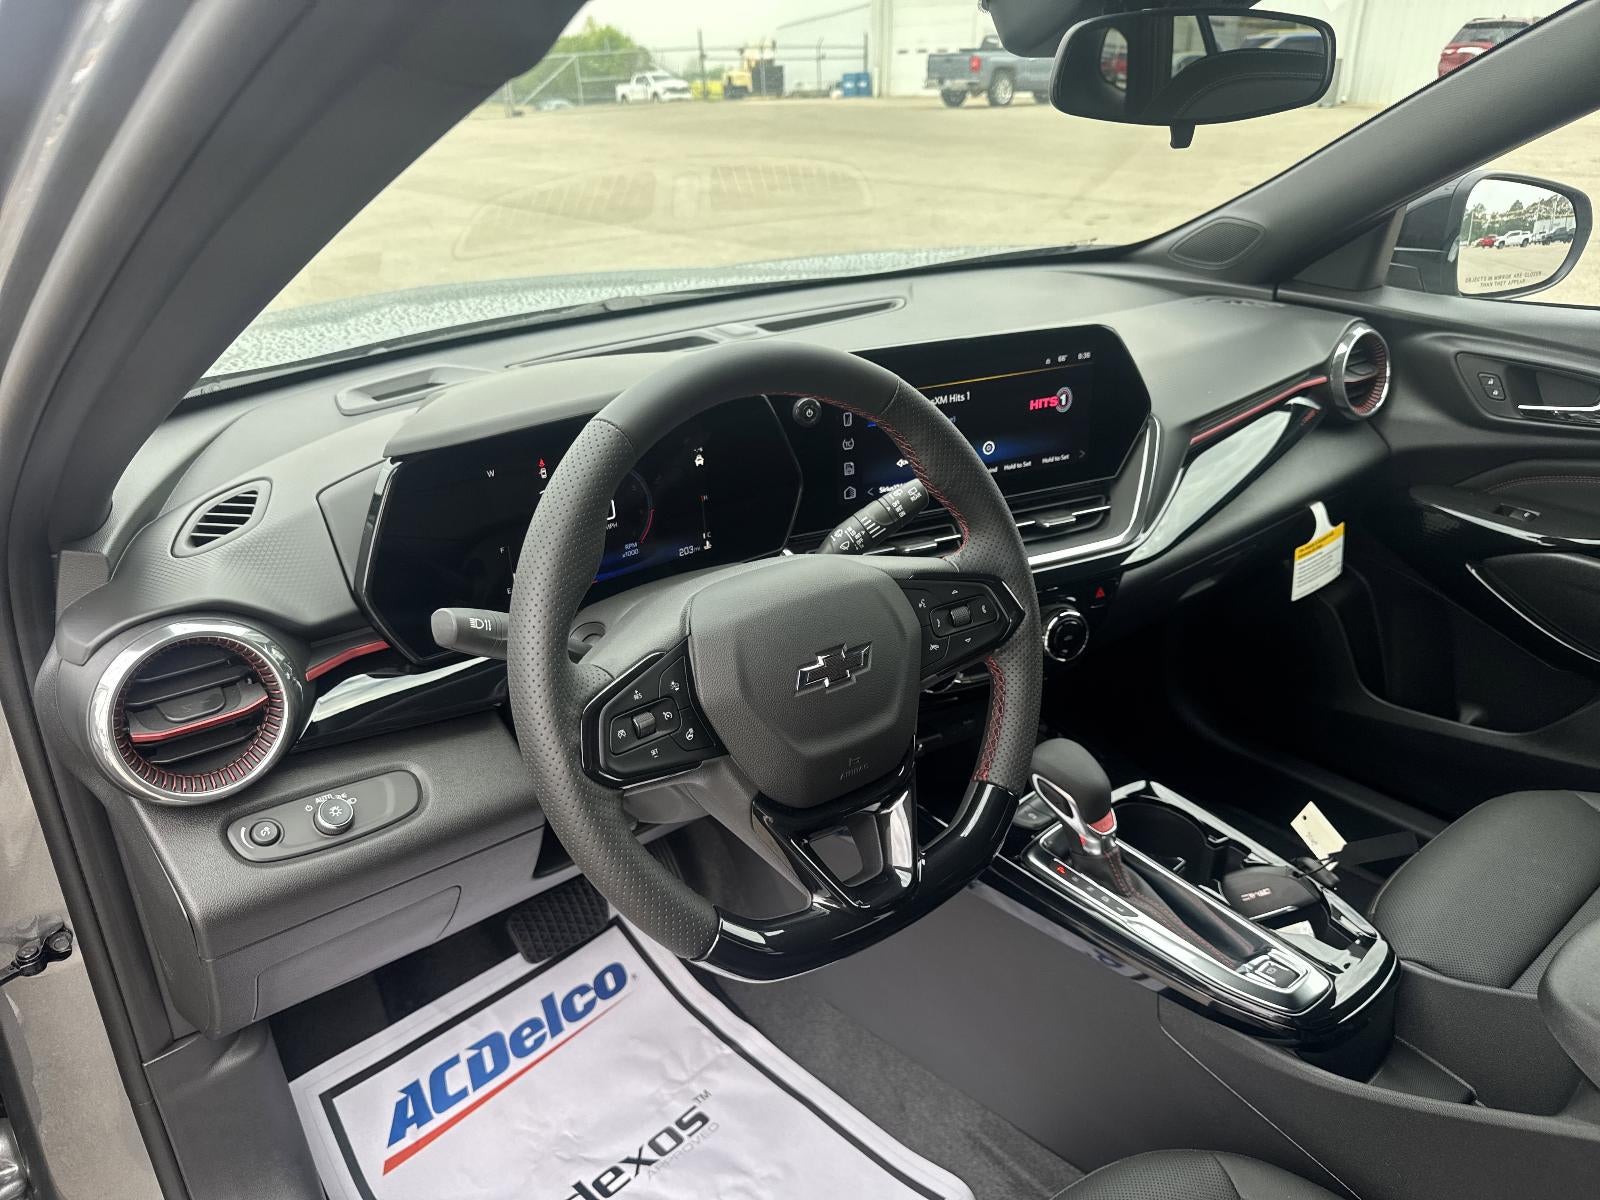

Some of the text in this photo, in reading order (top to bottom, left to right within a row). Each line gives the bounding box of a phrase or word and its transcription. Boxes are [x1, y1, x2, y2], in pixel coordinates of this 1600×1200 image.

[949, 393, 965, 403] Hits
[1061, 453, 1070, 461] Set
[1004, 463, 1016, 471] Hold
[486, 469, 495, 478] W
[625, 542, 638, 550] RPM
[679, 545, 694, 557] 203
[387, 962, 628, 1149] ACDelco
[647, 1121, 720, 1180] APPROVED
